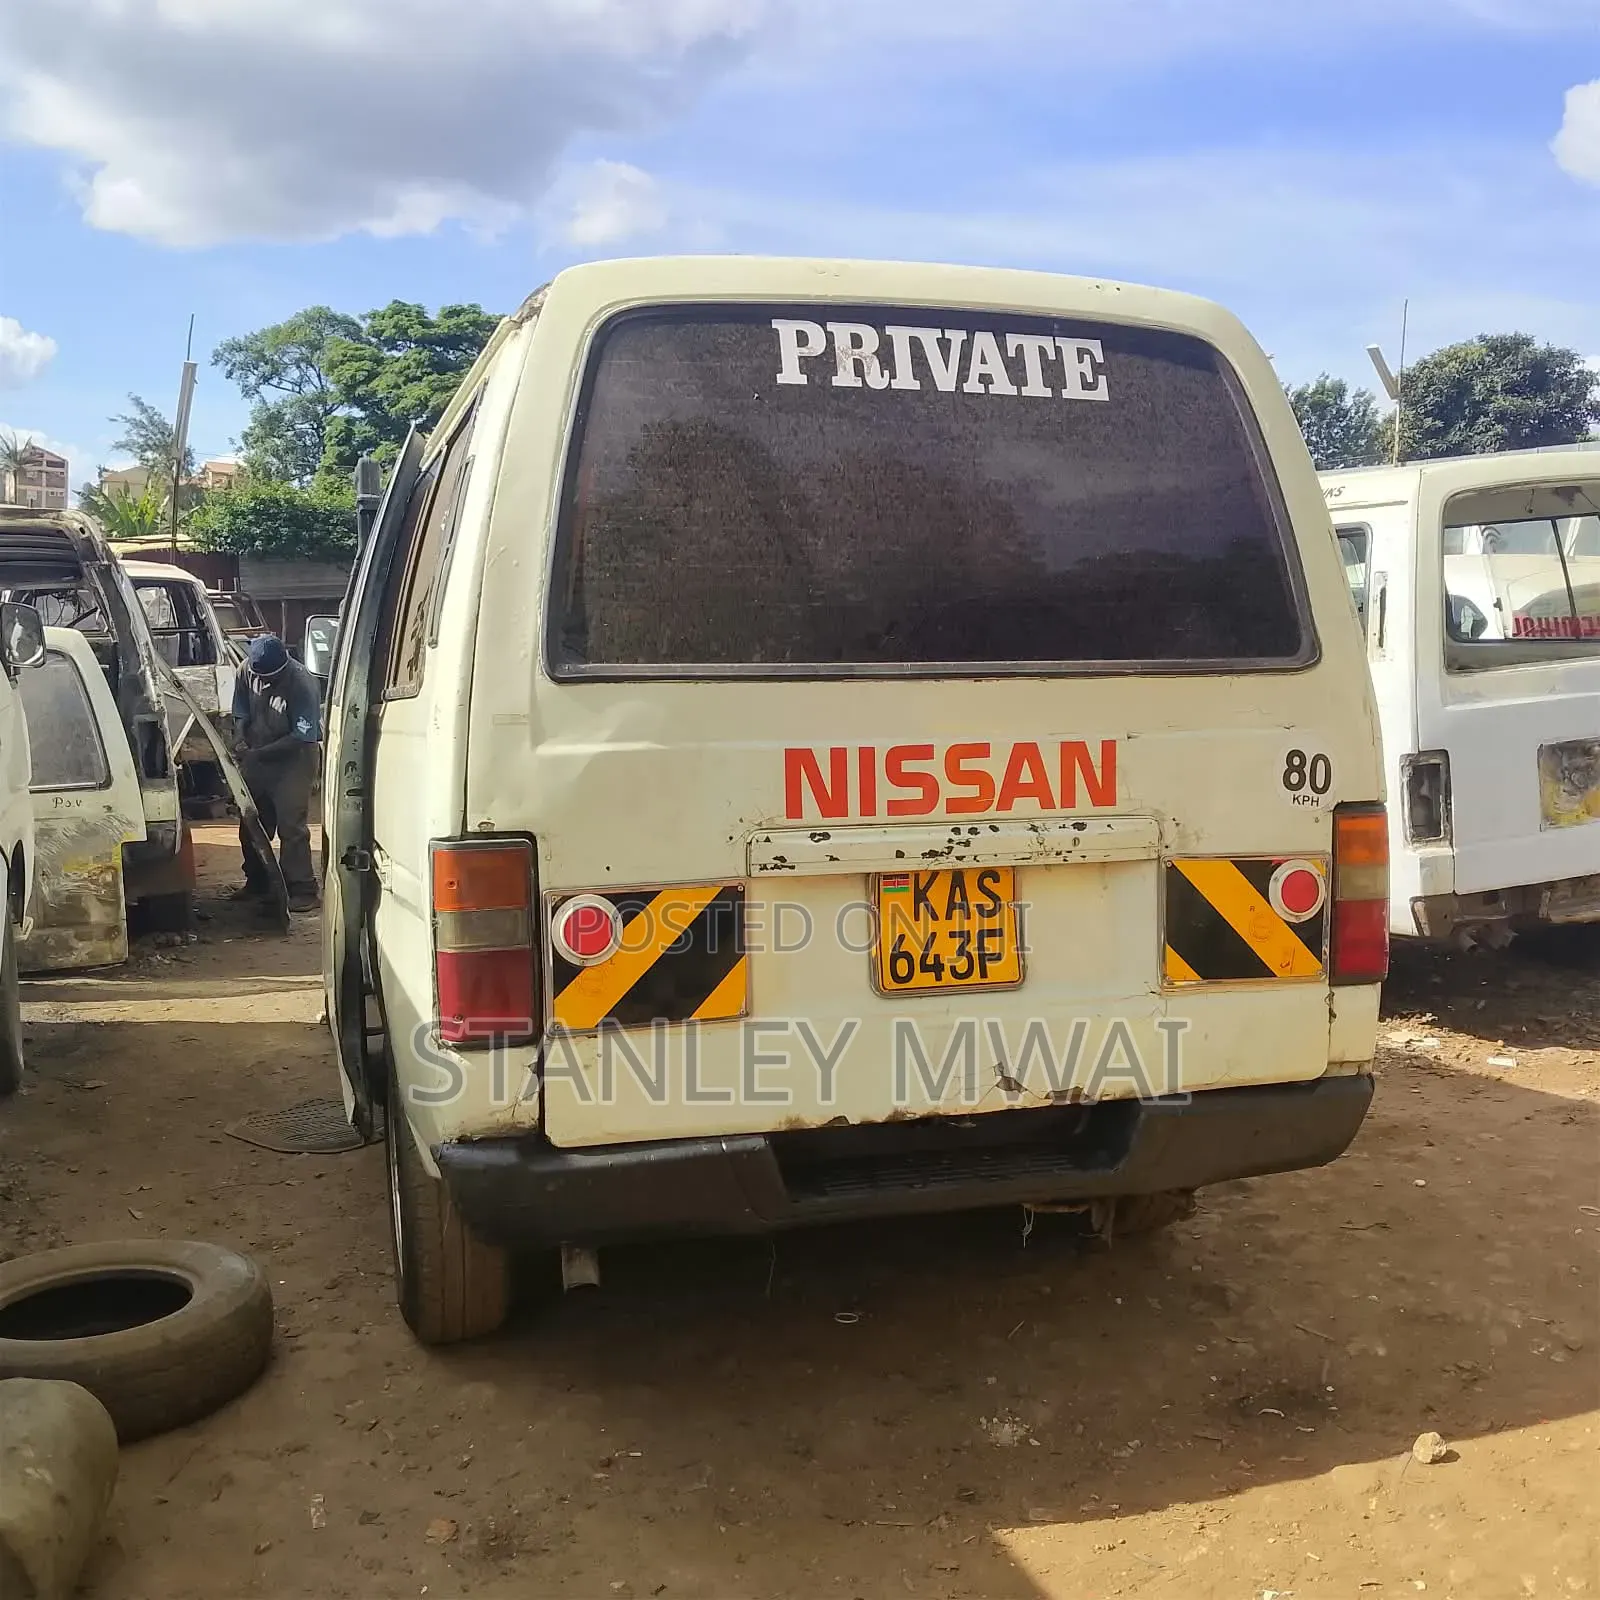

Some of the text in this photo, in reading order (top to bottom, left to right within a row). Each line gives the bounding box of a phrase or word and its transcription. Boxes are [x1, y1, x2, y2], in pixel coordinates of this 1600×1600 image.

[771, 318, 1110, 401] PRIVATE
[784, 739, 1117, 819] NISSAN
[1283, 749, 1332, 794] 80
[1292, 794, 1319, 807] KPH
[913, 869, 1002, 922] KAS
[889, 927, 1004, 985] 643F
